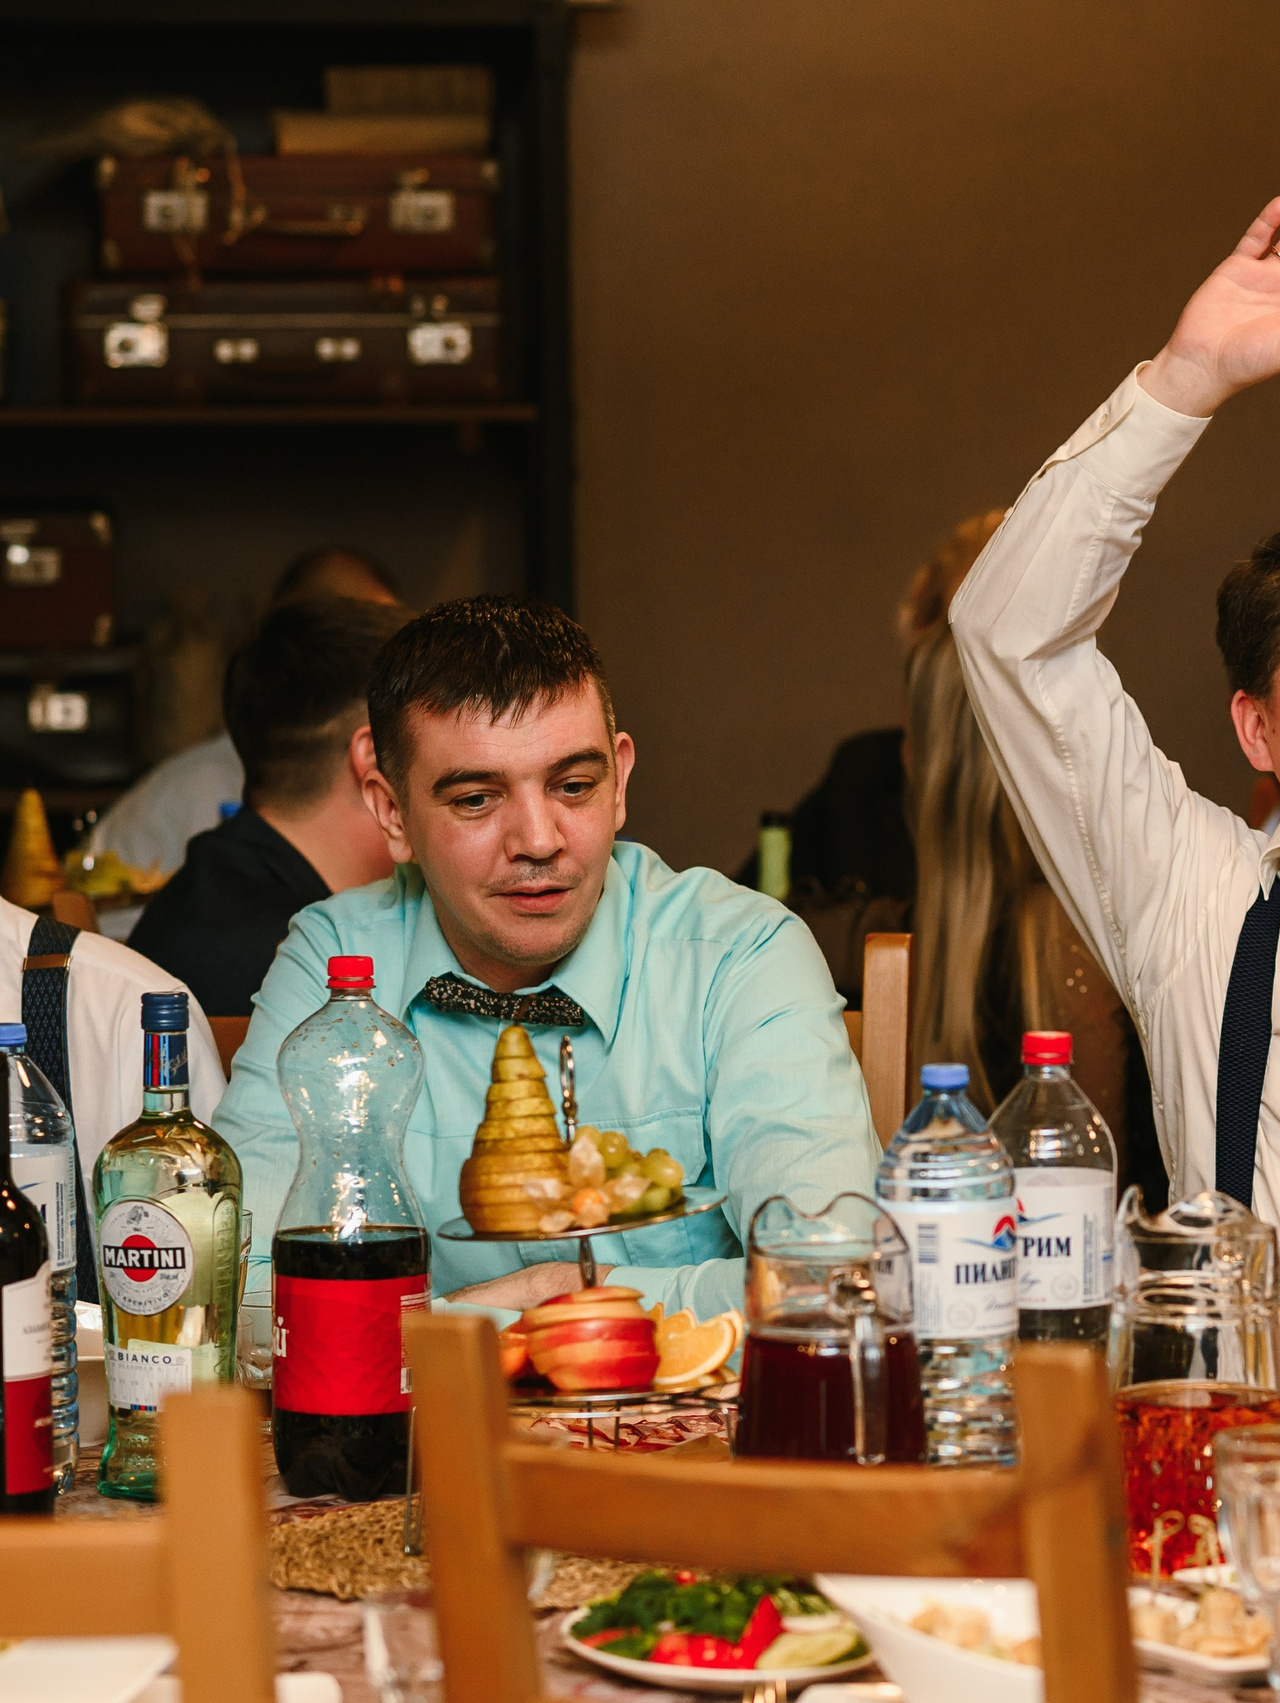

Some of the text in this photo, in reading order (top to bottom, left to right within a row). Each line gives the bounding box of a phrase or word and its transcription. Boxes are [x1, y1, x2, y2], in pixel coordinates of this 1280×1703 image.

[1017, 1235, 1071, 1257] РИМ
[104, 1247, 183, 1268] MARTINI
[117, 1352, 172, 1364] BIANCO
